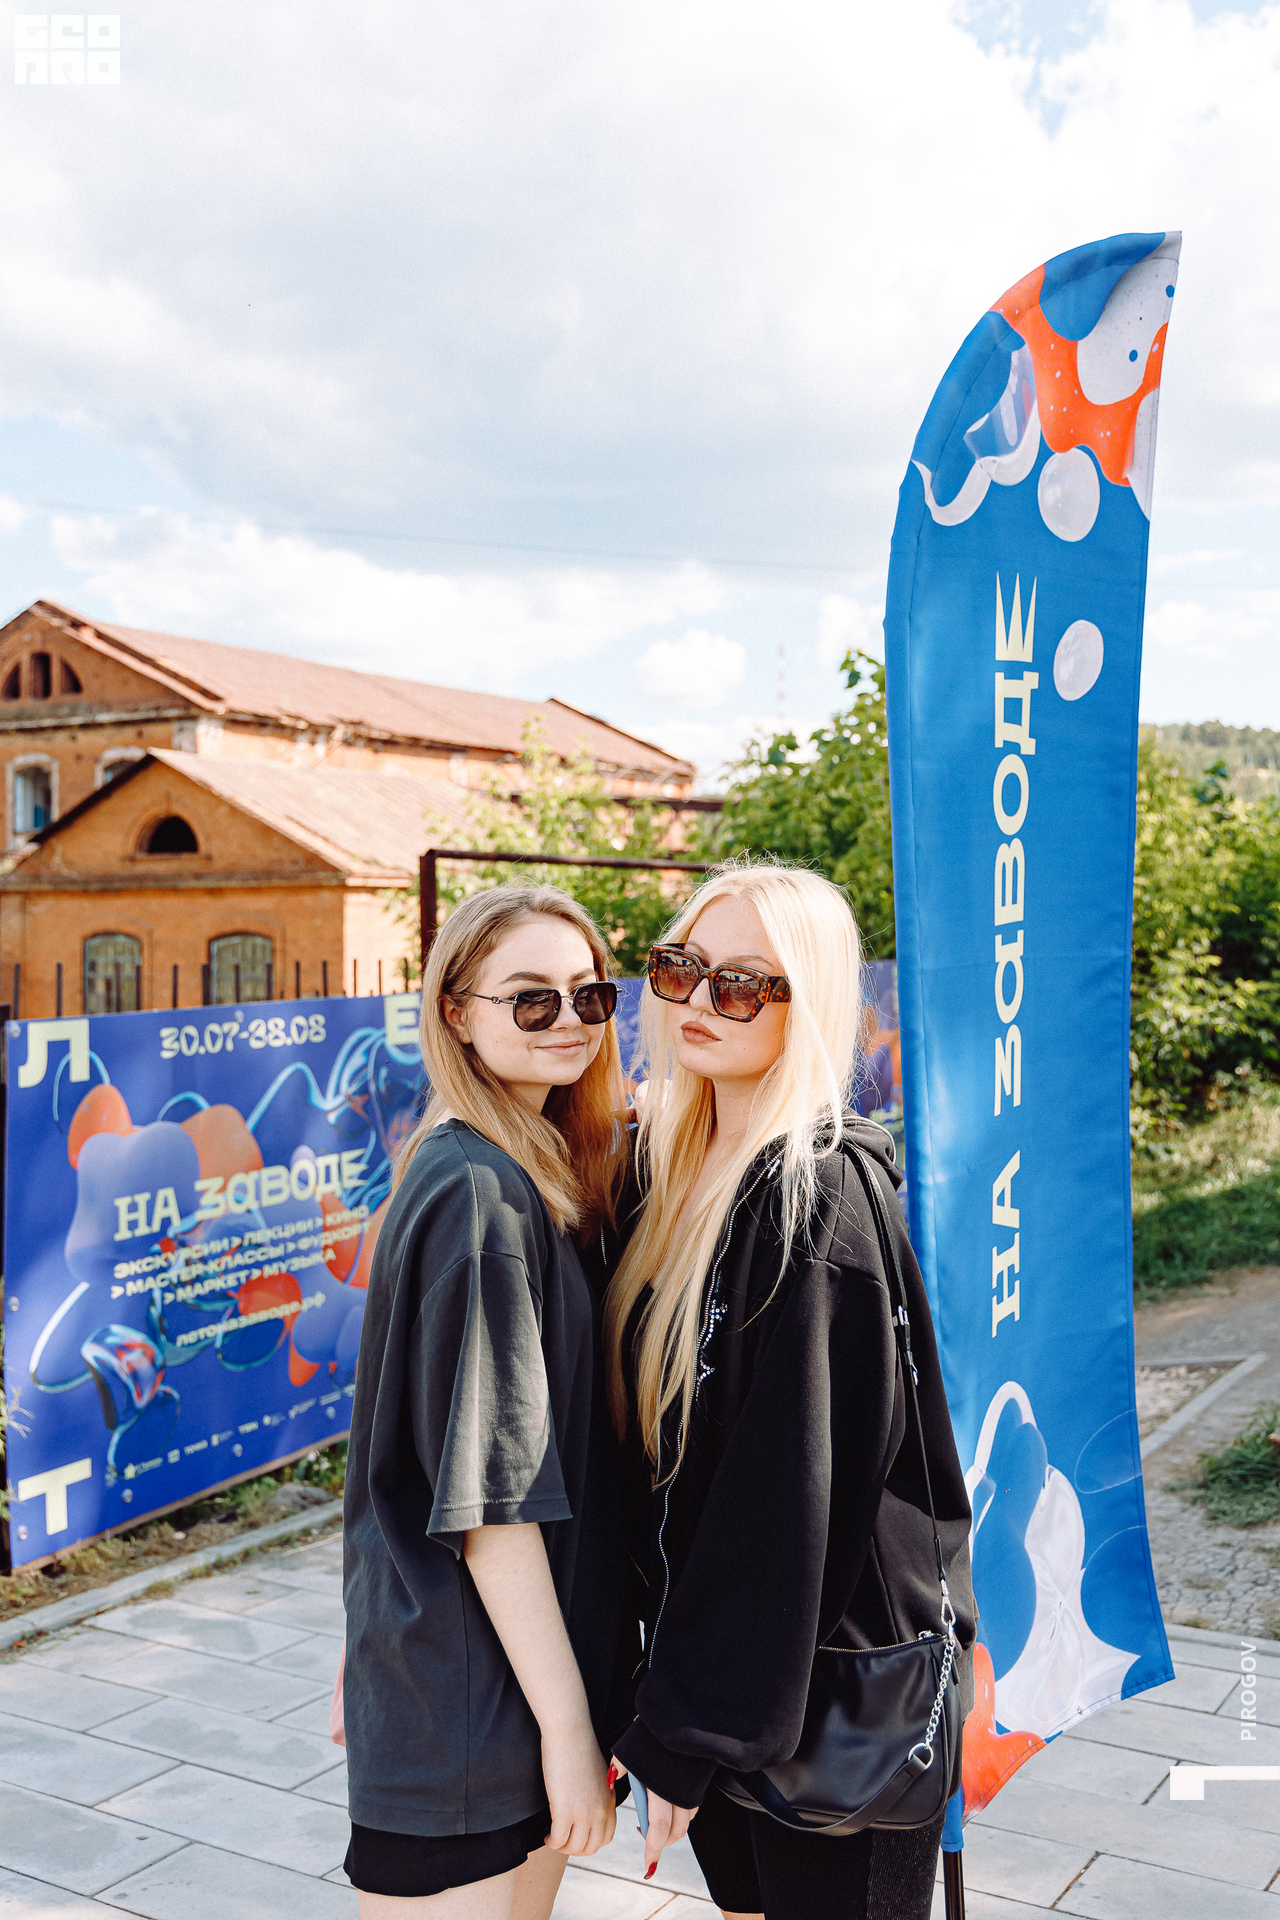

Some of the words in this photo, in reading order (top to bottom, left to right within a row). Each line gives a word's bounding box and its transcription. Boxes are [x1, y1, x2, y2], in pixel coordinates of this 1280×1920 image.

[18, 1018, 90, 1088] Л
[113, 1187, 181, 1242] НА
[325, 1205, 370, 1227] КИНО
[991, 1150, 1021, 1338] НА
[176, 1270, 250, 1303] МАРКЕТ
[262, 1248, 336, 1279] МУЗЫКА
[18, 1458, 92, 1536] Т
